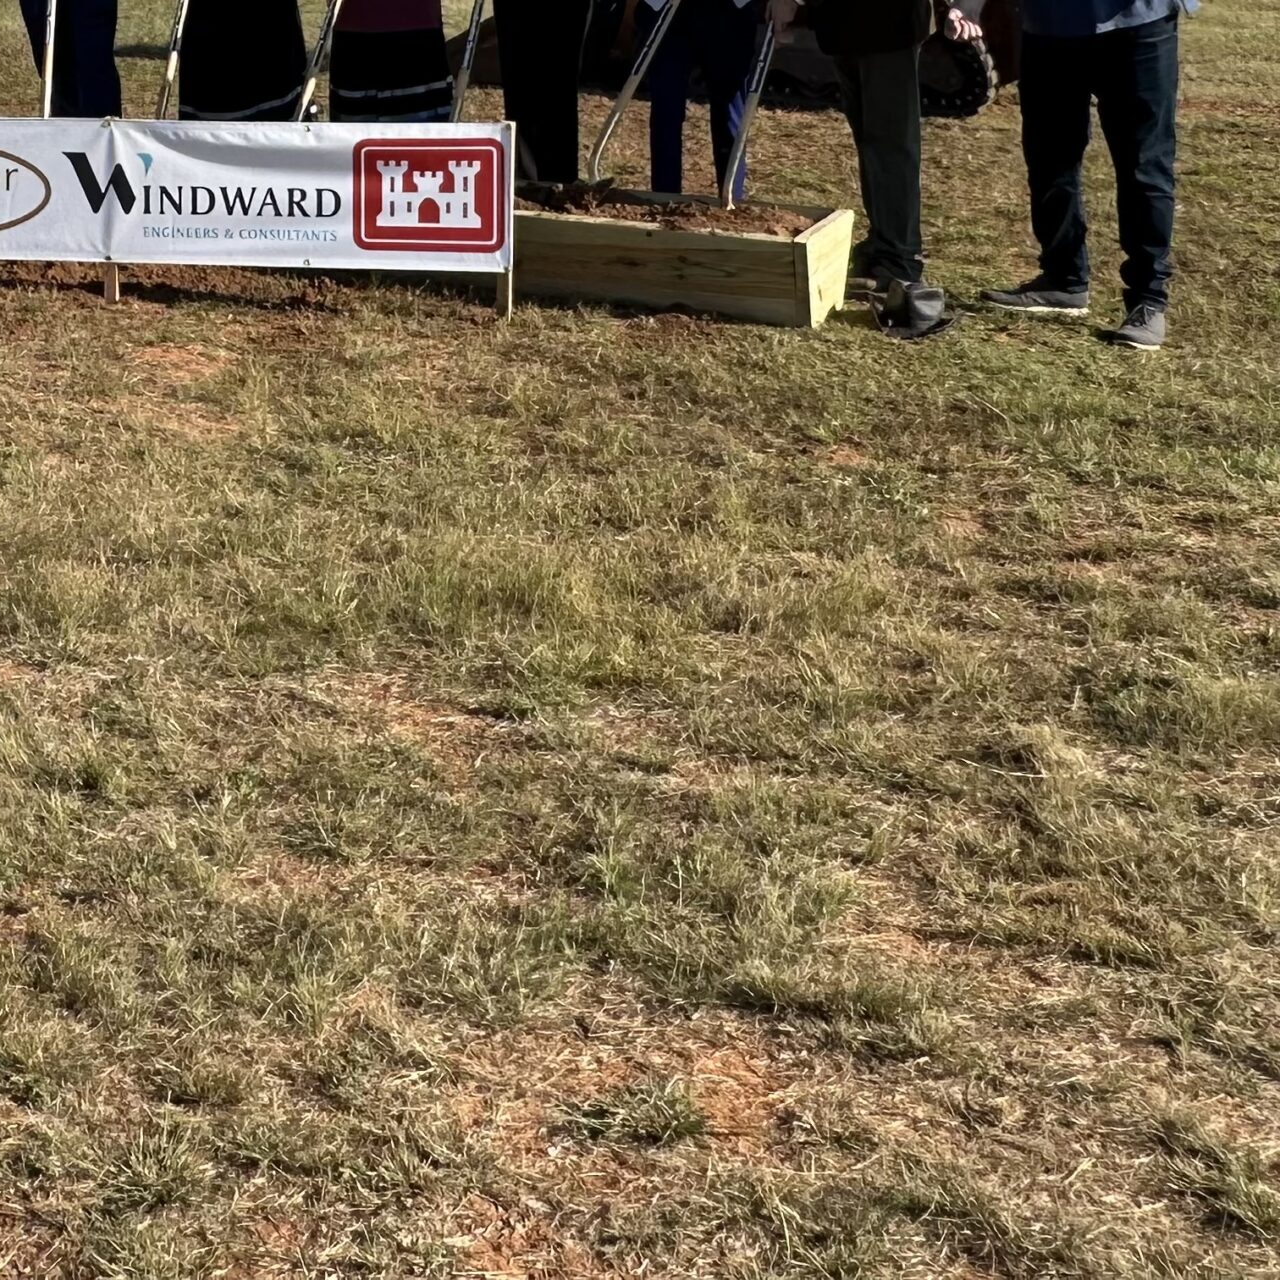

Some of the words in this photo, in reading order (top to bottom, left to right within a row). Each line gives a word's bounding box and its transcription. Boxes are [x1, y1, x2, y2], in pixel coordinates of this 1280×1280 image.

[61, 151, 342, 218] WINDWARD
[142, 226, 219, 239] ENGINEERS
[224, 227, 234, 239] &
[239, 228, 338, 243] CONSULTANTS
